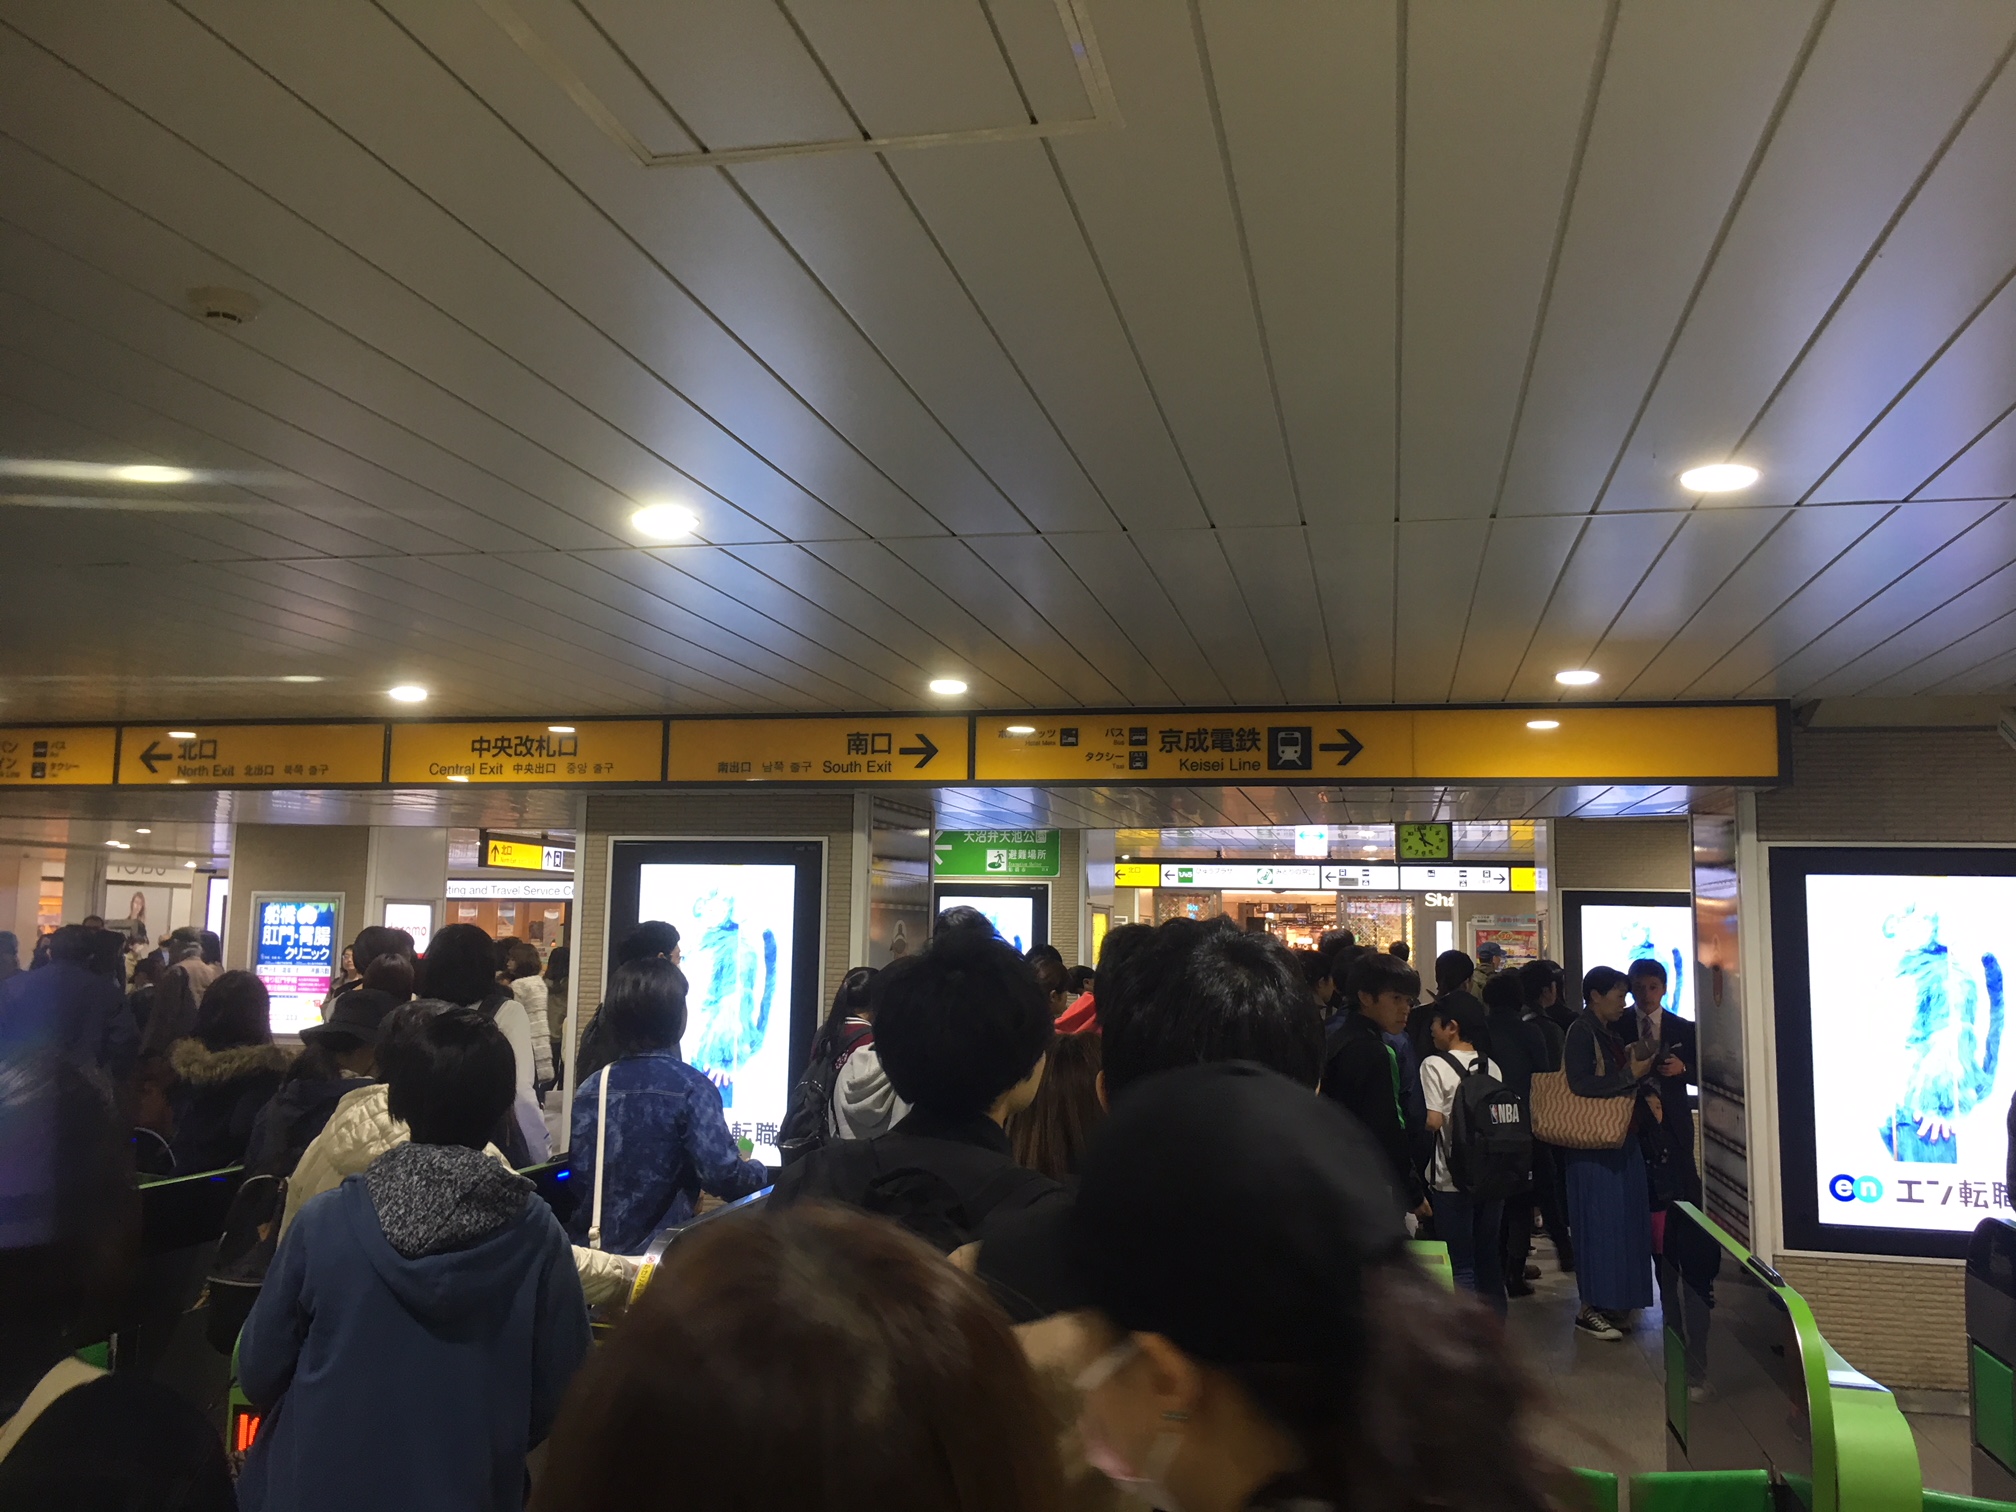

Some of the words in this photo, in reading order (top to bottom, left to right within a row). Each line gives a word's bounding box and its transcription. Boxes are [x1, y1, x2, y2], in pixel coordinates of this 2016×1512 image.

[1105, 728, 1125, 738] バス
[471, 736, 579, 758] 中央改札口
[847, 732, 893, 755] 南口
[1159, 728, 1262, 753] 京成電鉄
[178, 739, 218, 761] 北口
[1085, 752, 1125, 762] タクシー
[177, 765, 209, 777] North
[213, 764, 235, 777] Exit
[244, 764, 275, 777] 北出口
[429, 762, 475, 776] Central
[480, 762, 503, 776] Exit
[513, 763, 557, 775] 中央出口
[566, 763, 588, 774] 중앙
[717, 762, 752, 774] 南出口
[823, 760, 862, 774] South
[867, 760, 892, 773] Exit
[1179, 759, 1224, 772] Keisei
[1230, 759, 1261, 772] Line
[1008, 849, 1047, 860] 避難場所
[469, 886, 488, 896] and
[491, 886, 521, 896] Travel
[523, 886, 560, 896] Service
[284, 947, 330, 961] クリニック
[1499, 1103, 1520, 1123] NBA
[1833, 1177, 1880, 1200] en
